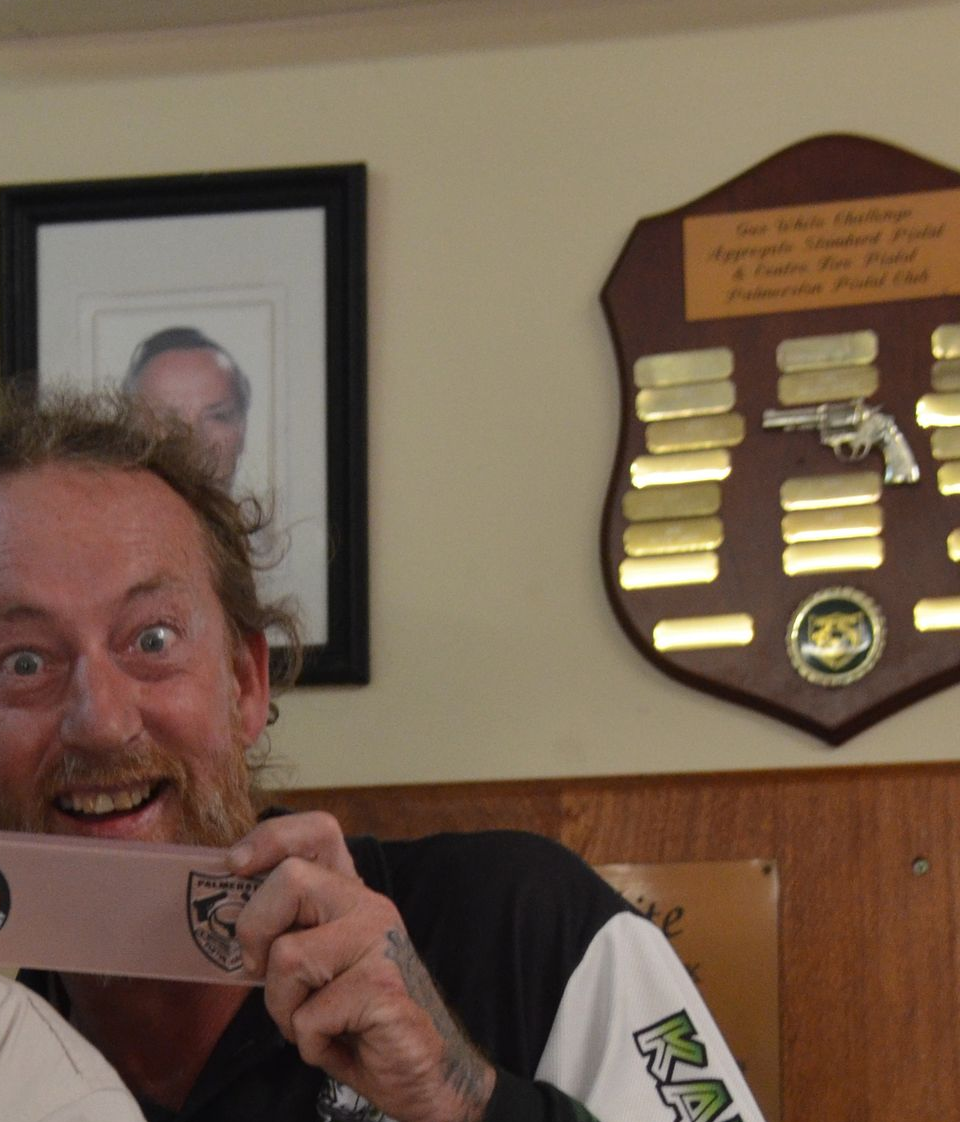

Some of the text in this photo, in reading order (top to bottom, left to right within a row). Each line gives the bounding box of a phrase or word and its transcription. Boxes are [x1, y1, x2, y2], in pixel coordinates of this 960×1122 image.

[833, 208, 912, 226] Challenge
[805, 231, 881, 249] Standard
[893, 222, 946, 241] Pistol
[754, 261, 808, 277] Centre
[819, 254, 851, 270] Fire
[866, 248, 918, 267] Pistol
[728, 268, 928, 302] Palmerston Pistol Club
